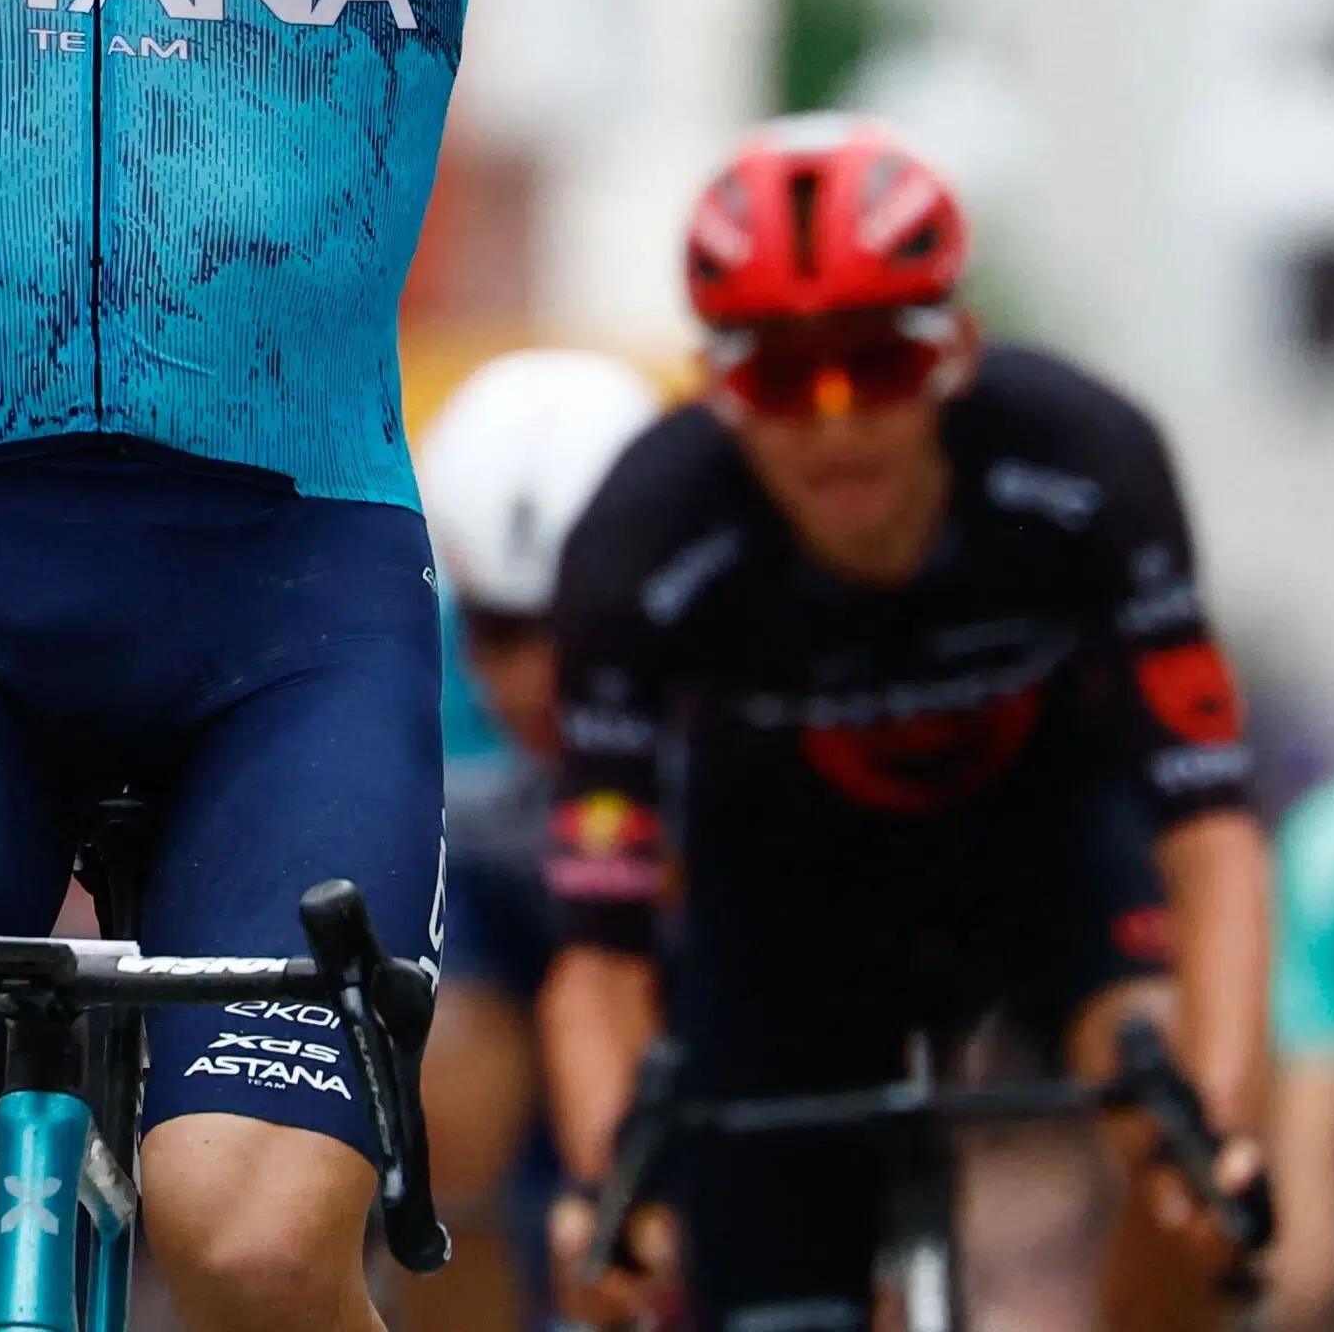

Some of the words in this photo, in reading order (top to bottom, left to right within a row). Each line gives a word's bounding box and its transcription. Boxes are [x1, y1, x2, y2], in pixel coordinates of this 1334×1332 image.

[28, 28, 189, 60] TEAM
[183, 1056, 352, 1100] ASTANA
[247, 1077, 286, 1090] TEAM
